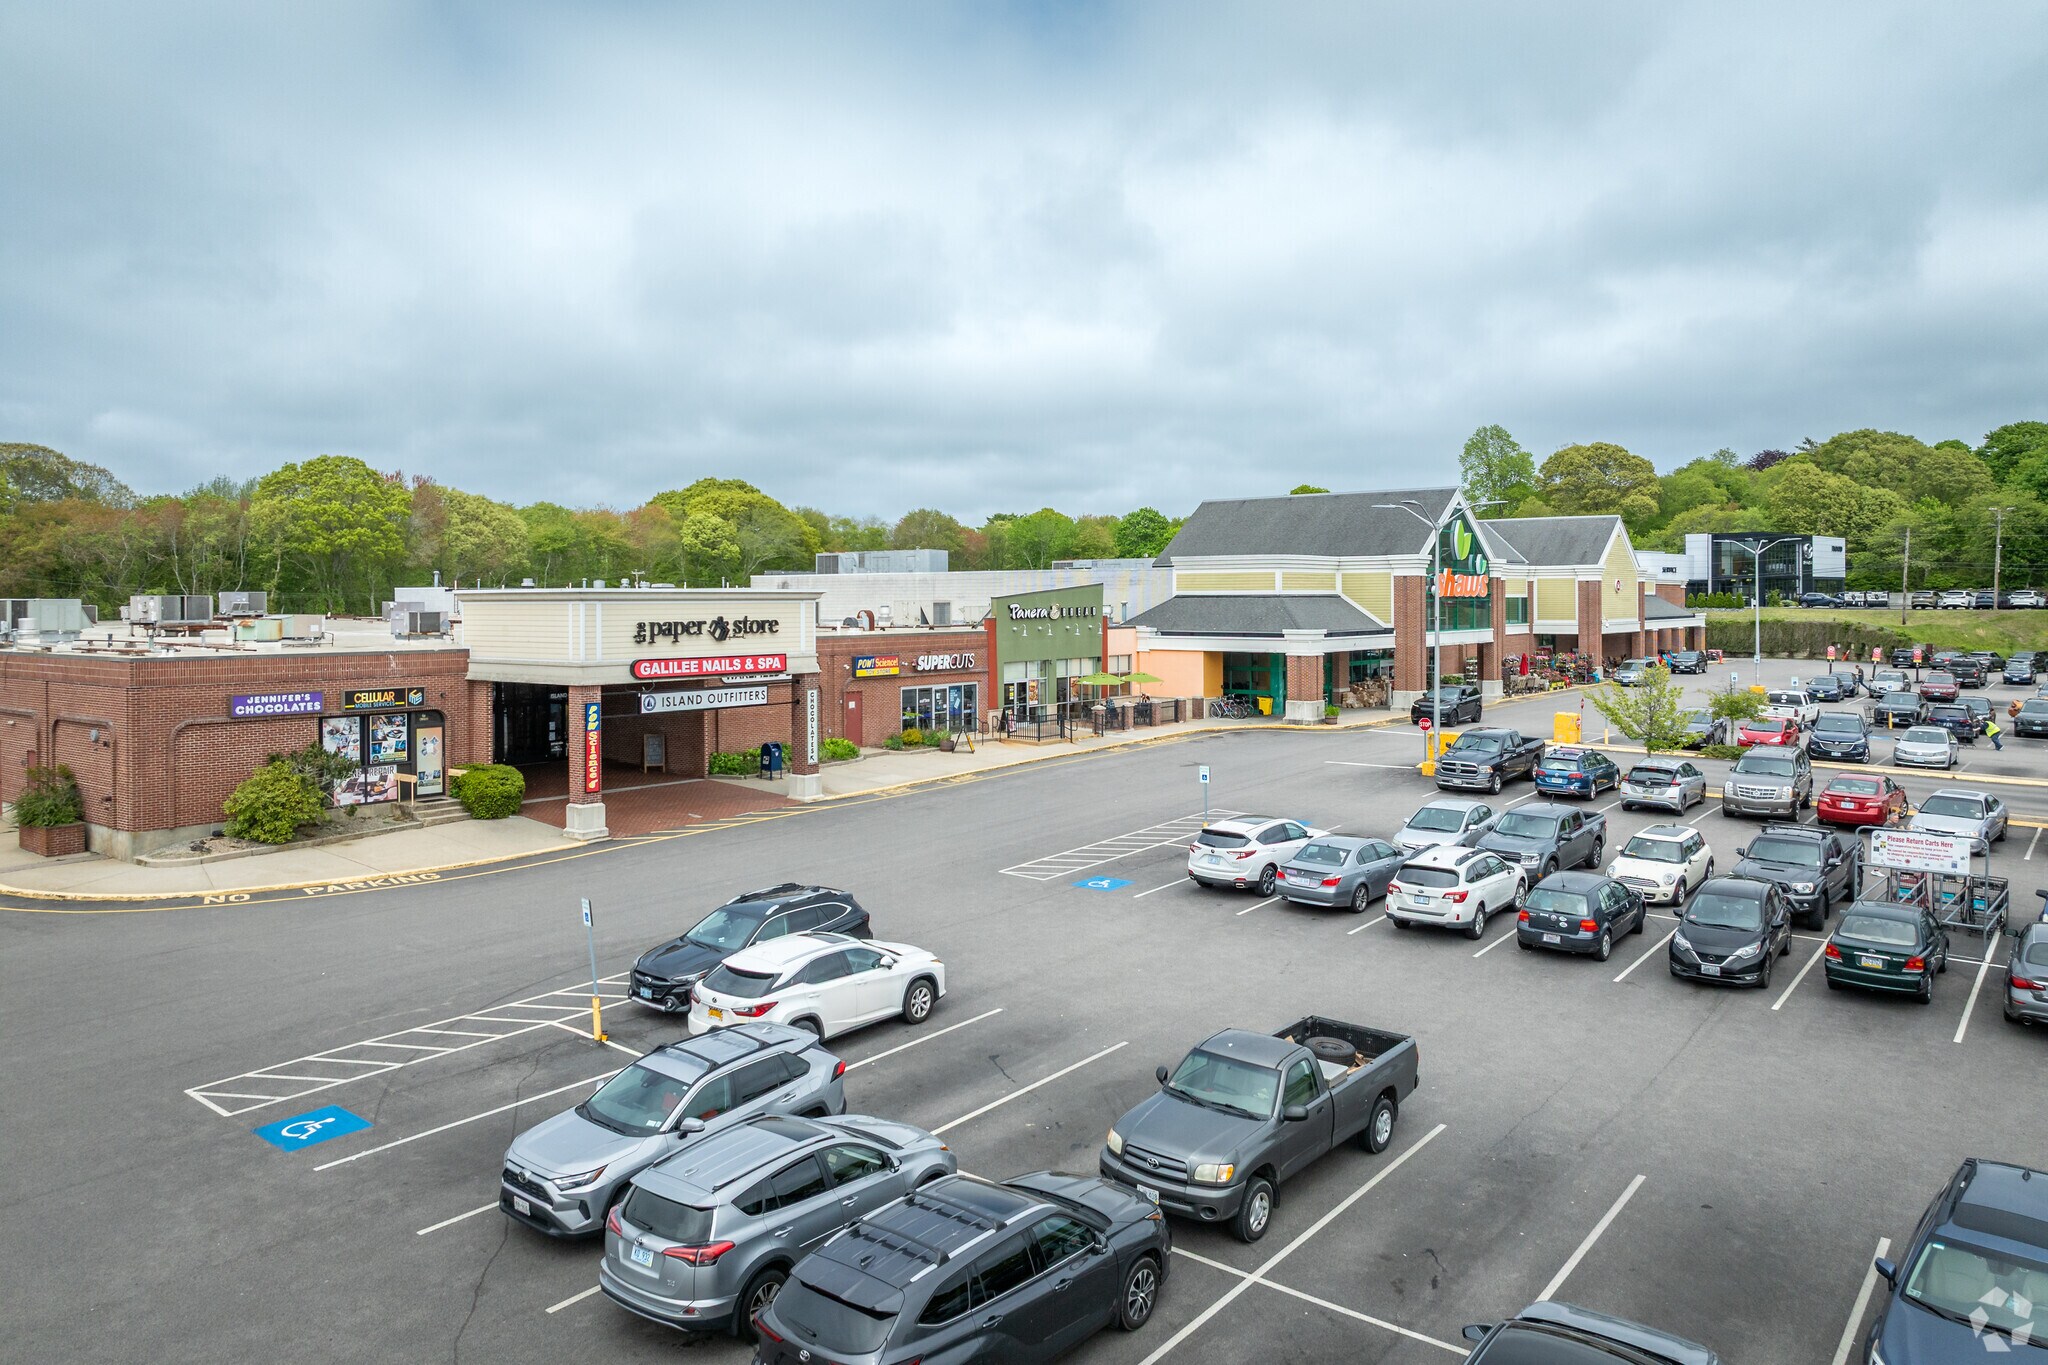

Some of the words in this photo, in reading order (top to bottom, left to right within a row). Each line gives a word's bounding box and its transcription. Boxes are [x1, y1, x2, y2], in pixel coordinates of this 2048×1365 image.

[1432, 568, 1488, 597] shaws
[1008, 604, 1048, 620] Panera
[1061, 607, 1096, 618] BREAD
[633, 622, 646, 644] the
[648, 620, 706, 644] paper
[733, 616, 779, 634] store
[640, 661, 698, 675] GALILEE
[702, 658, 741, 672] NAILS
[745, 658, 754, 669] &
[758, 657, 781, 668] SPA
[858, 658, 875, 668] POW!
[875, 657, 898, 667] Science!
[917, 653, 975, 671] SUPERCUTS
[247, 694, 310, 704] JENNIFER'S
[354, 692, 395, 703] CELLULAR
[662, 694, 702, 707] ISLAND
[708, 690, 766, 704] OUTFITTERS
[235, 702, 320, 715] CHOCOLATES
[587, 706, 599, 730] POW
[368, 766, 394, 776] REPAIR
[203, 894, 250, 904] NO
[302, 872, 441, 895] PARKING
